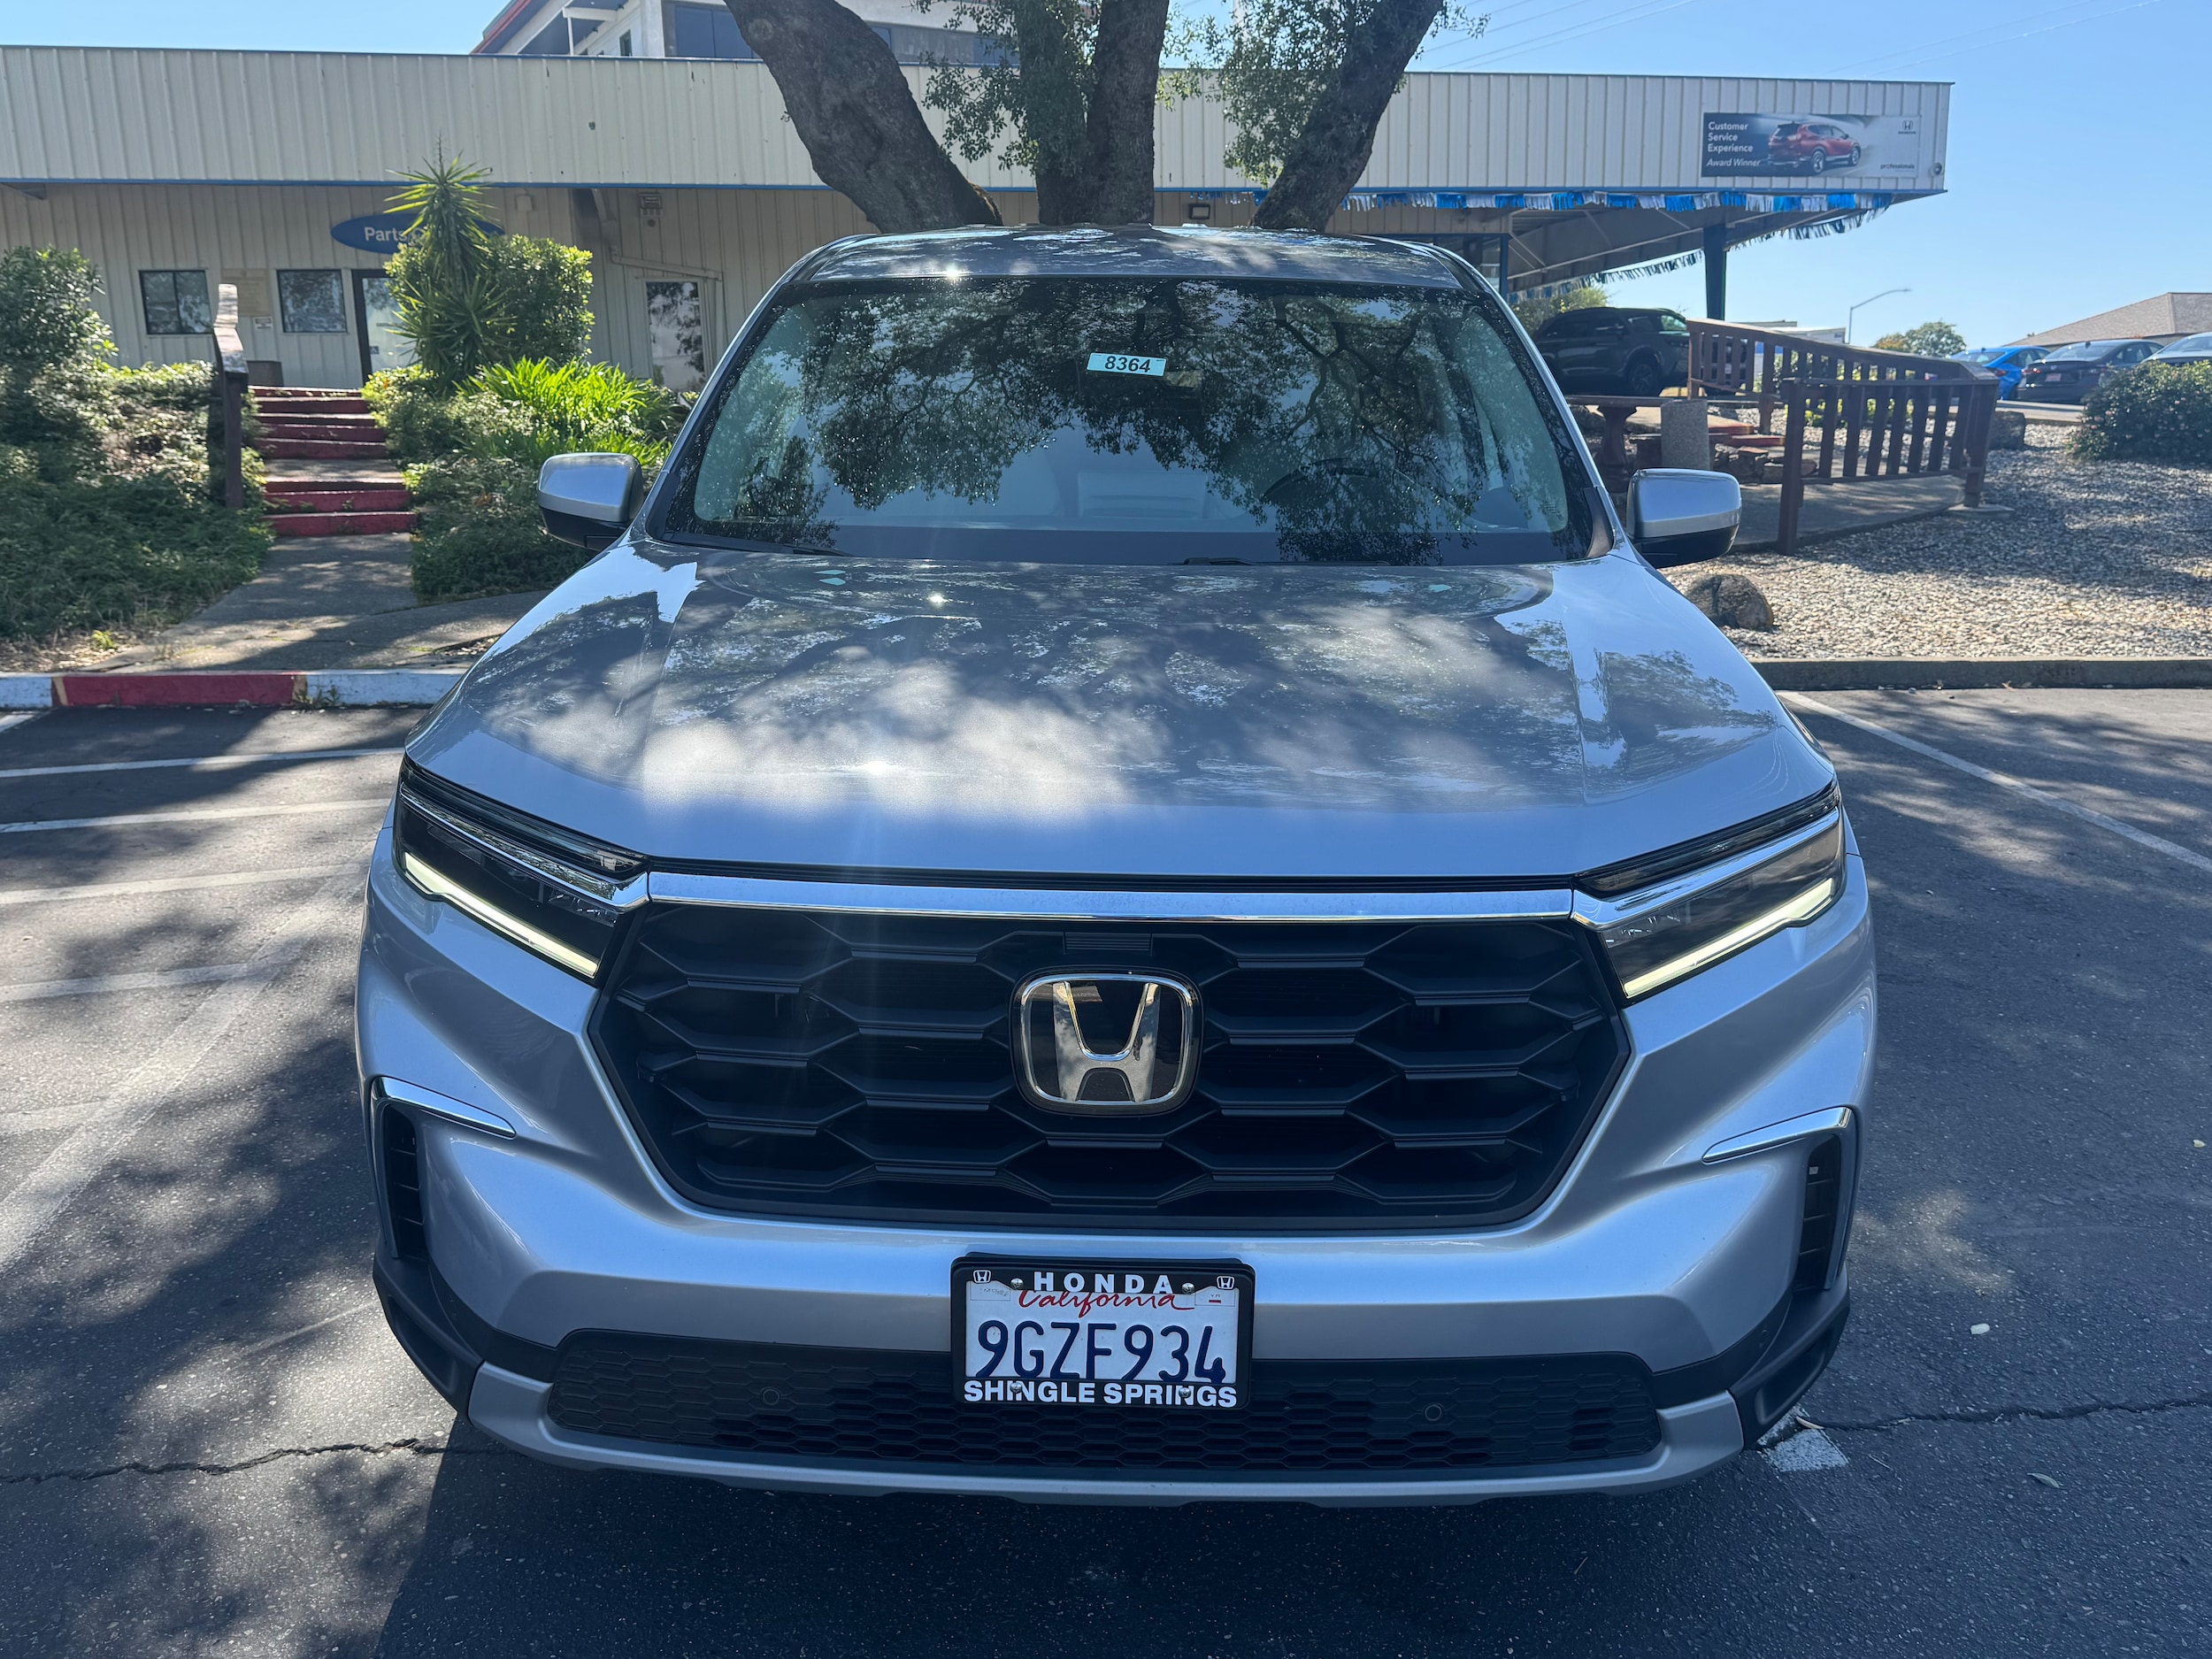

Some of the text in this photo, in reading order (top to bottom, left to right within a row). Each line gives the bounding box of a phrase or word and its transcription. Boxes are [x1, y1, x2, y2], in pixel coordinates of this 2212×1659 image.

[1708, 121, 1748, 131] Customer
[1708, 132, 1739, 142] Service
[1707, 143, 1754, 154] Experience
[364, 227, 408, 242] Parts
[1104, 356, 1151, 373] 8364
[1033, 1271, 1173, 1294] HONDA
[1018, 1290, 1194, 1318] California
[975, 1320, 1226, 1384] 9GZF934
[964, 1380, 1238, 1408] SHINGLE SPRINGS
